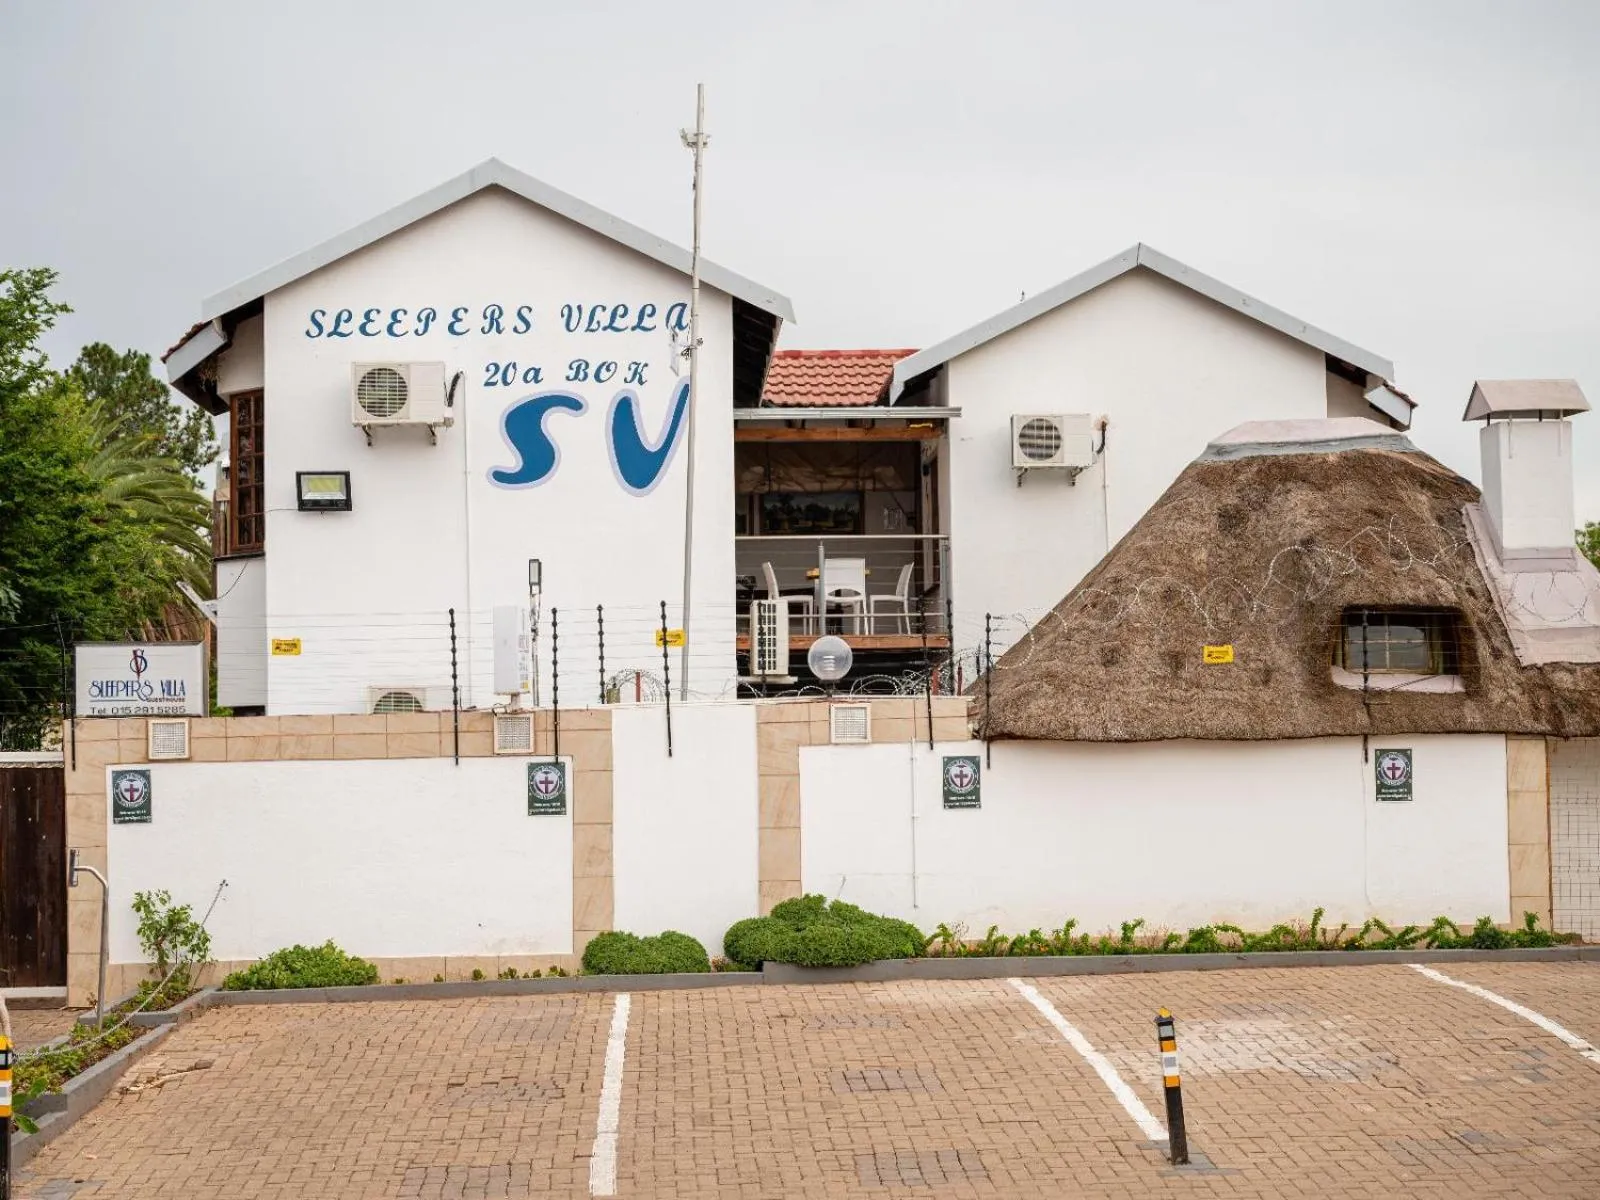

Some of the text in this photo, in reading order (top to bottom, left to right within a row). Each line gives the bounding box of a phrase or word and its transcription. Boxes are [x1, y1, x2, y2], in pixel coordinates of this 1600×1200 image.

[305, 304, 533, 338] SLEEPERS
[483, 358, 649, 387] 20a BOK
[89, 679, 186, 701] SLEEPERS VILLA
